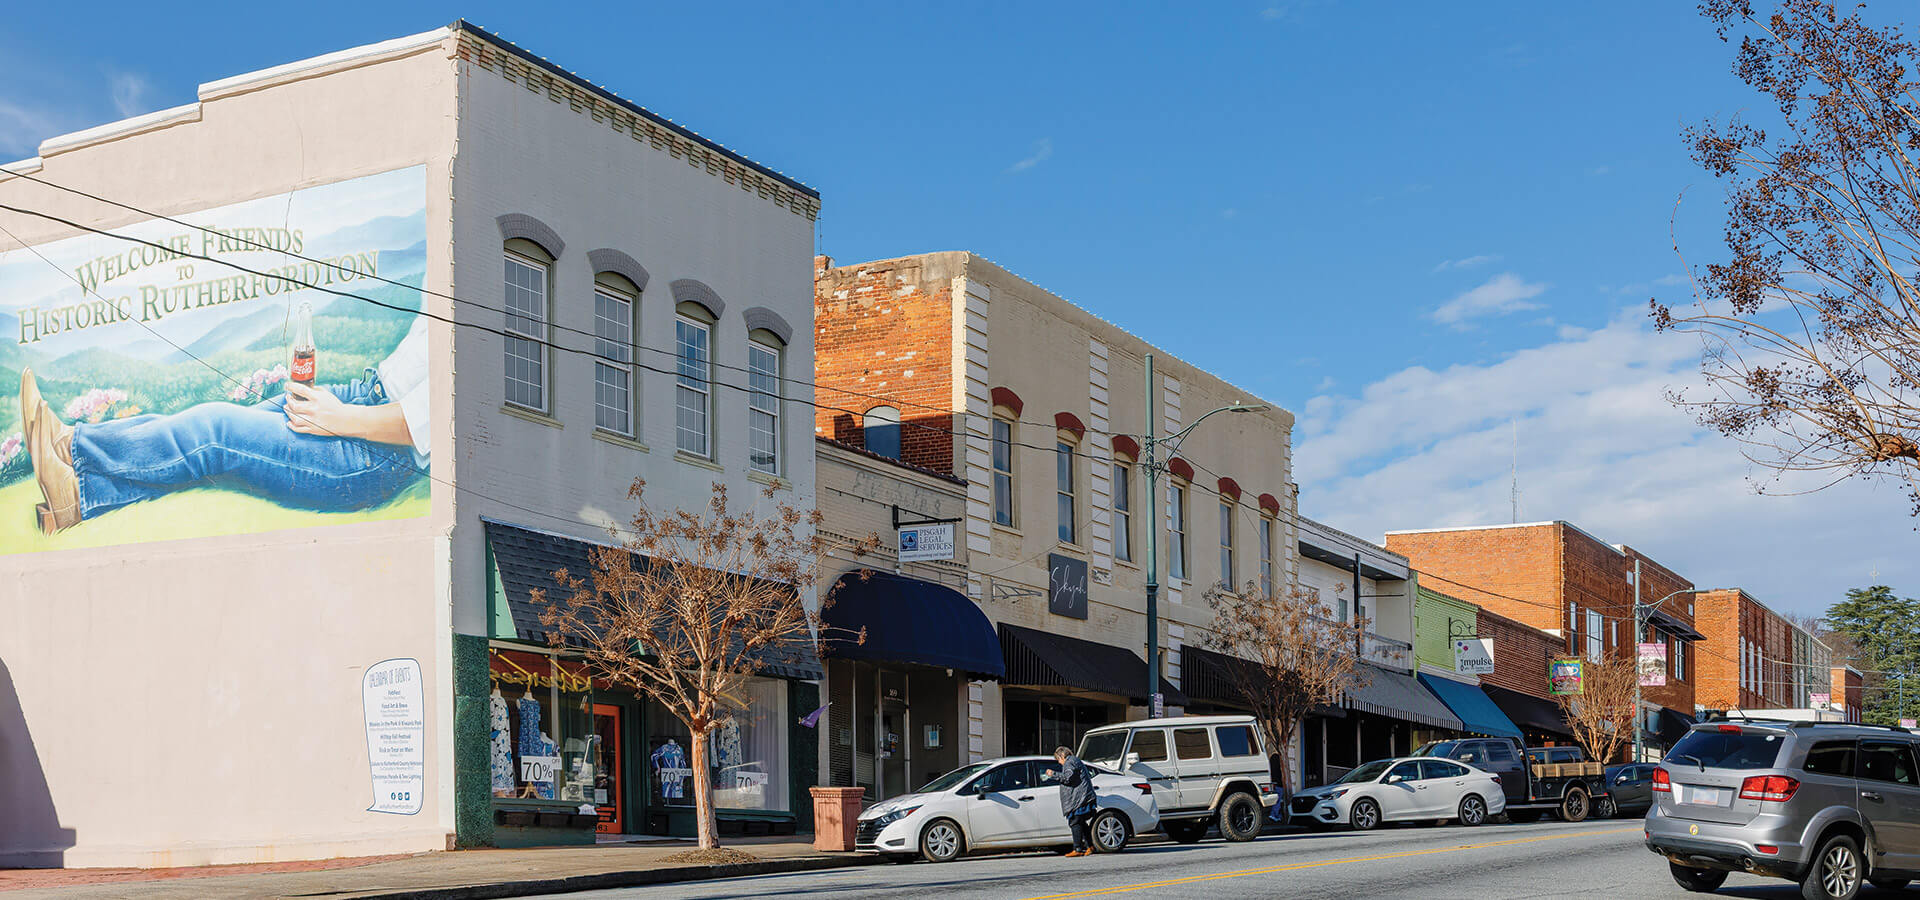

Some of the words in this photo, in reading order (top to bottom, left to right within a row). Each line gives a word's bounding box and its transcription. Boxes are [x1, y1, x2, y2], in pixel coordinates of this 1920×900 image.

[74, 234, 192, 297] WELCOME
[201, 224, 304, 258] FRIENDS
[176, 264, 195, 281] TO
[17, 295, 132, 345] HISTORIC
[138, 250, 379, 323] RUTHERFORDTON
[919, 527, 946, 536] PISGAH
[919, 535, 944, 543] LEGAL
[919, 543, 953, 551] SERVICES
[522, 761, 553, 781] 70%
